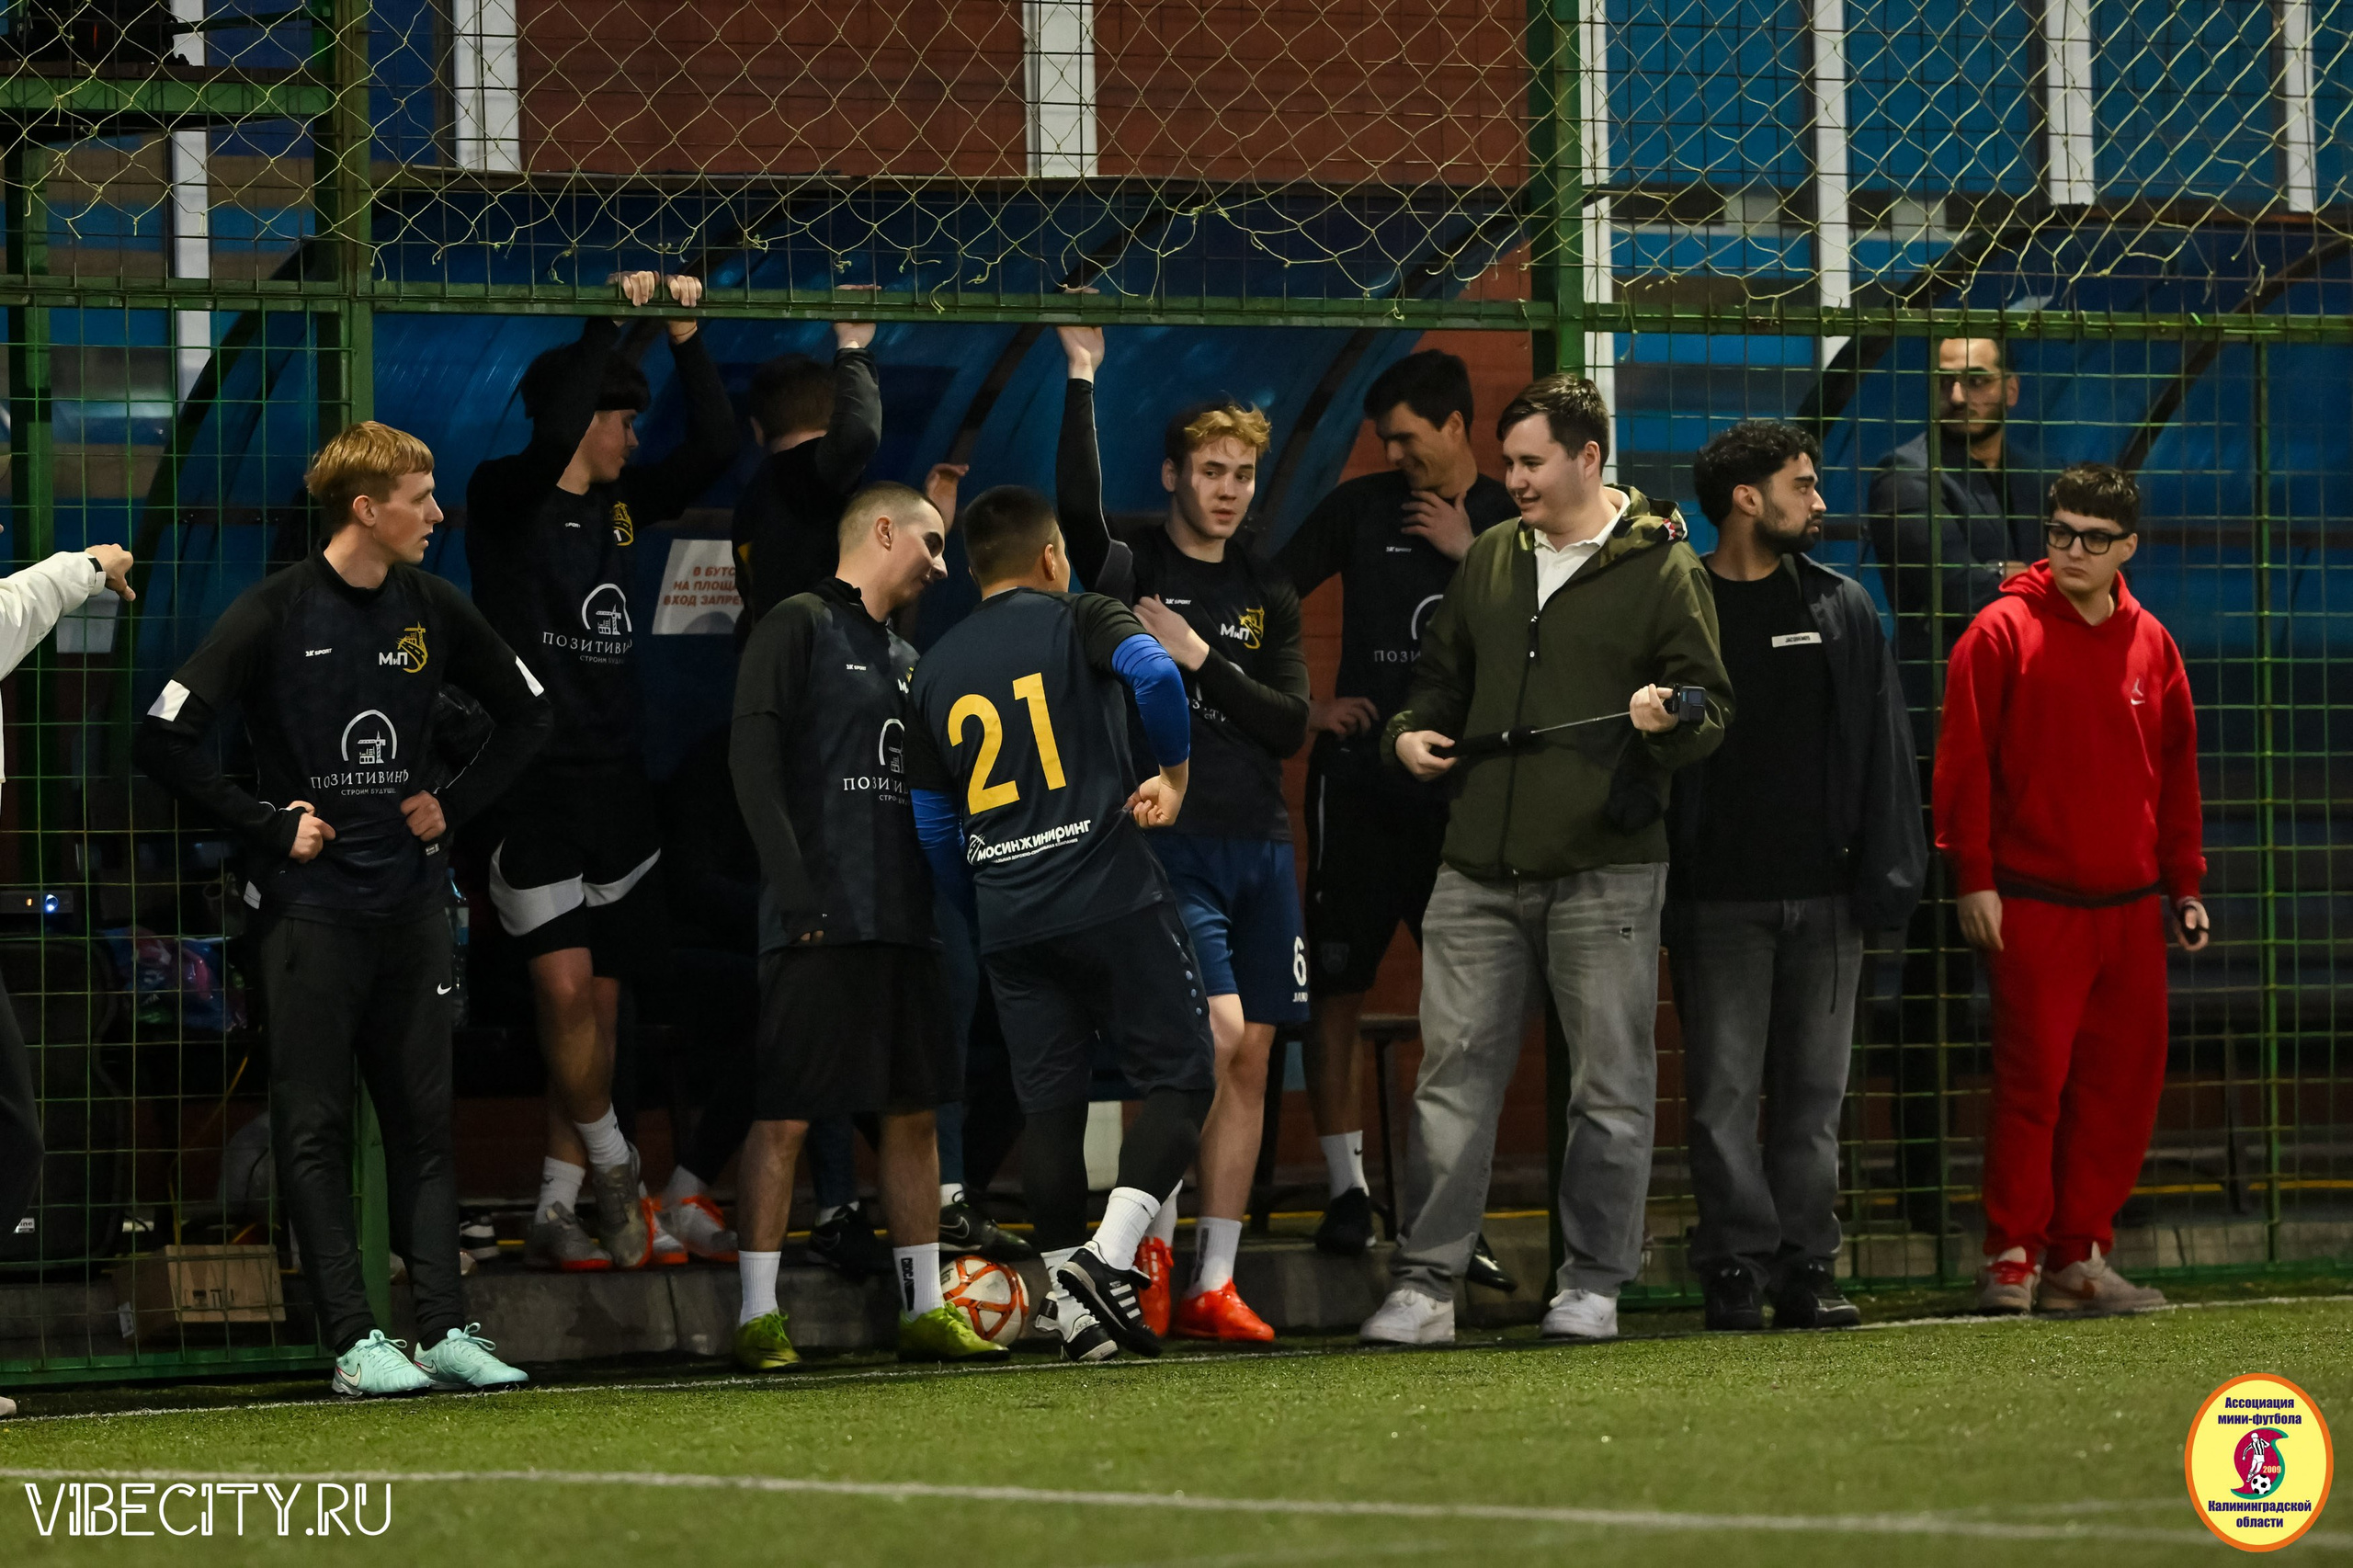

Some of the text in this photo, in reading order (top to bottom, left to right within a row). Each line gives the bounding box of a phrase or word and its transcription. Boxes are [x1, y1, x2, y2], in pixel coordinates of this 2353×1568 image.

[704, 566, 736, 577] БУТС
[673, 581, 690, 591] НА
[663, 595, 744, 608] ВХОД ЗАПРЕ
[1374, 650, 1421, 662] ПОЗИ
[948, 672, 1067, 815] 21
[341, 788, 369, 796] СТРОИМ
[1293, 936, 1307, 987] 6
